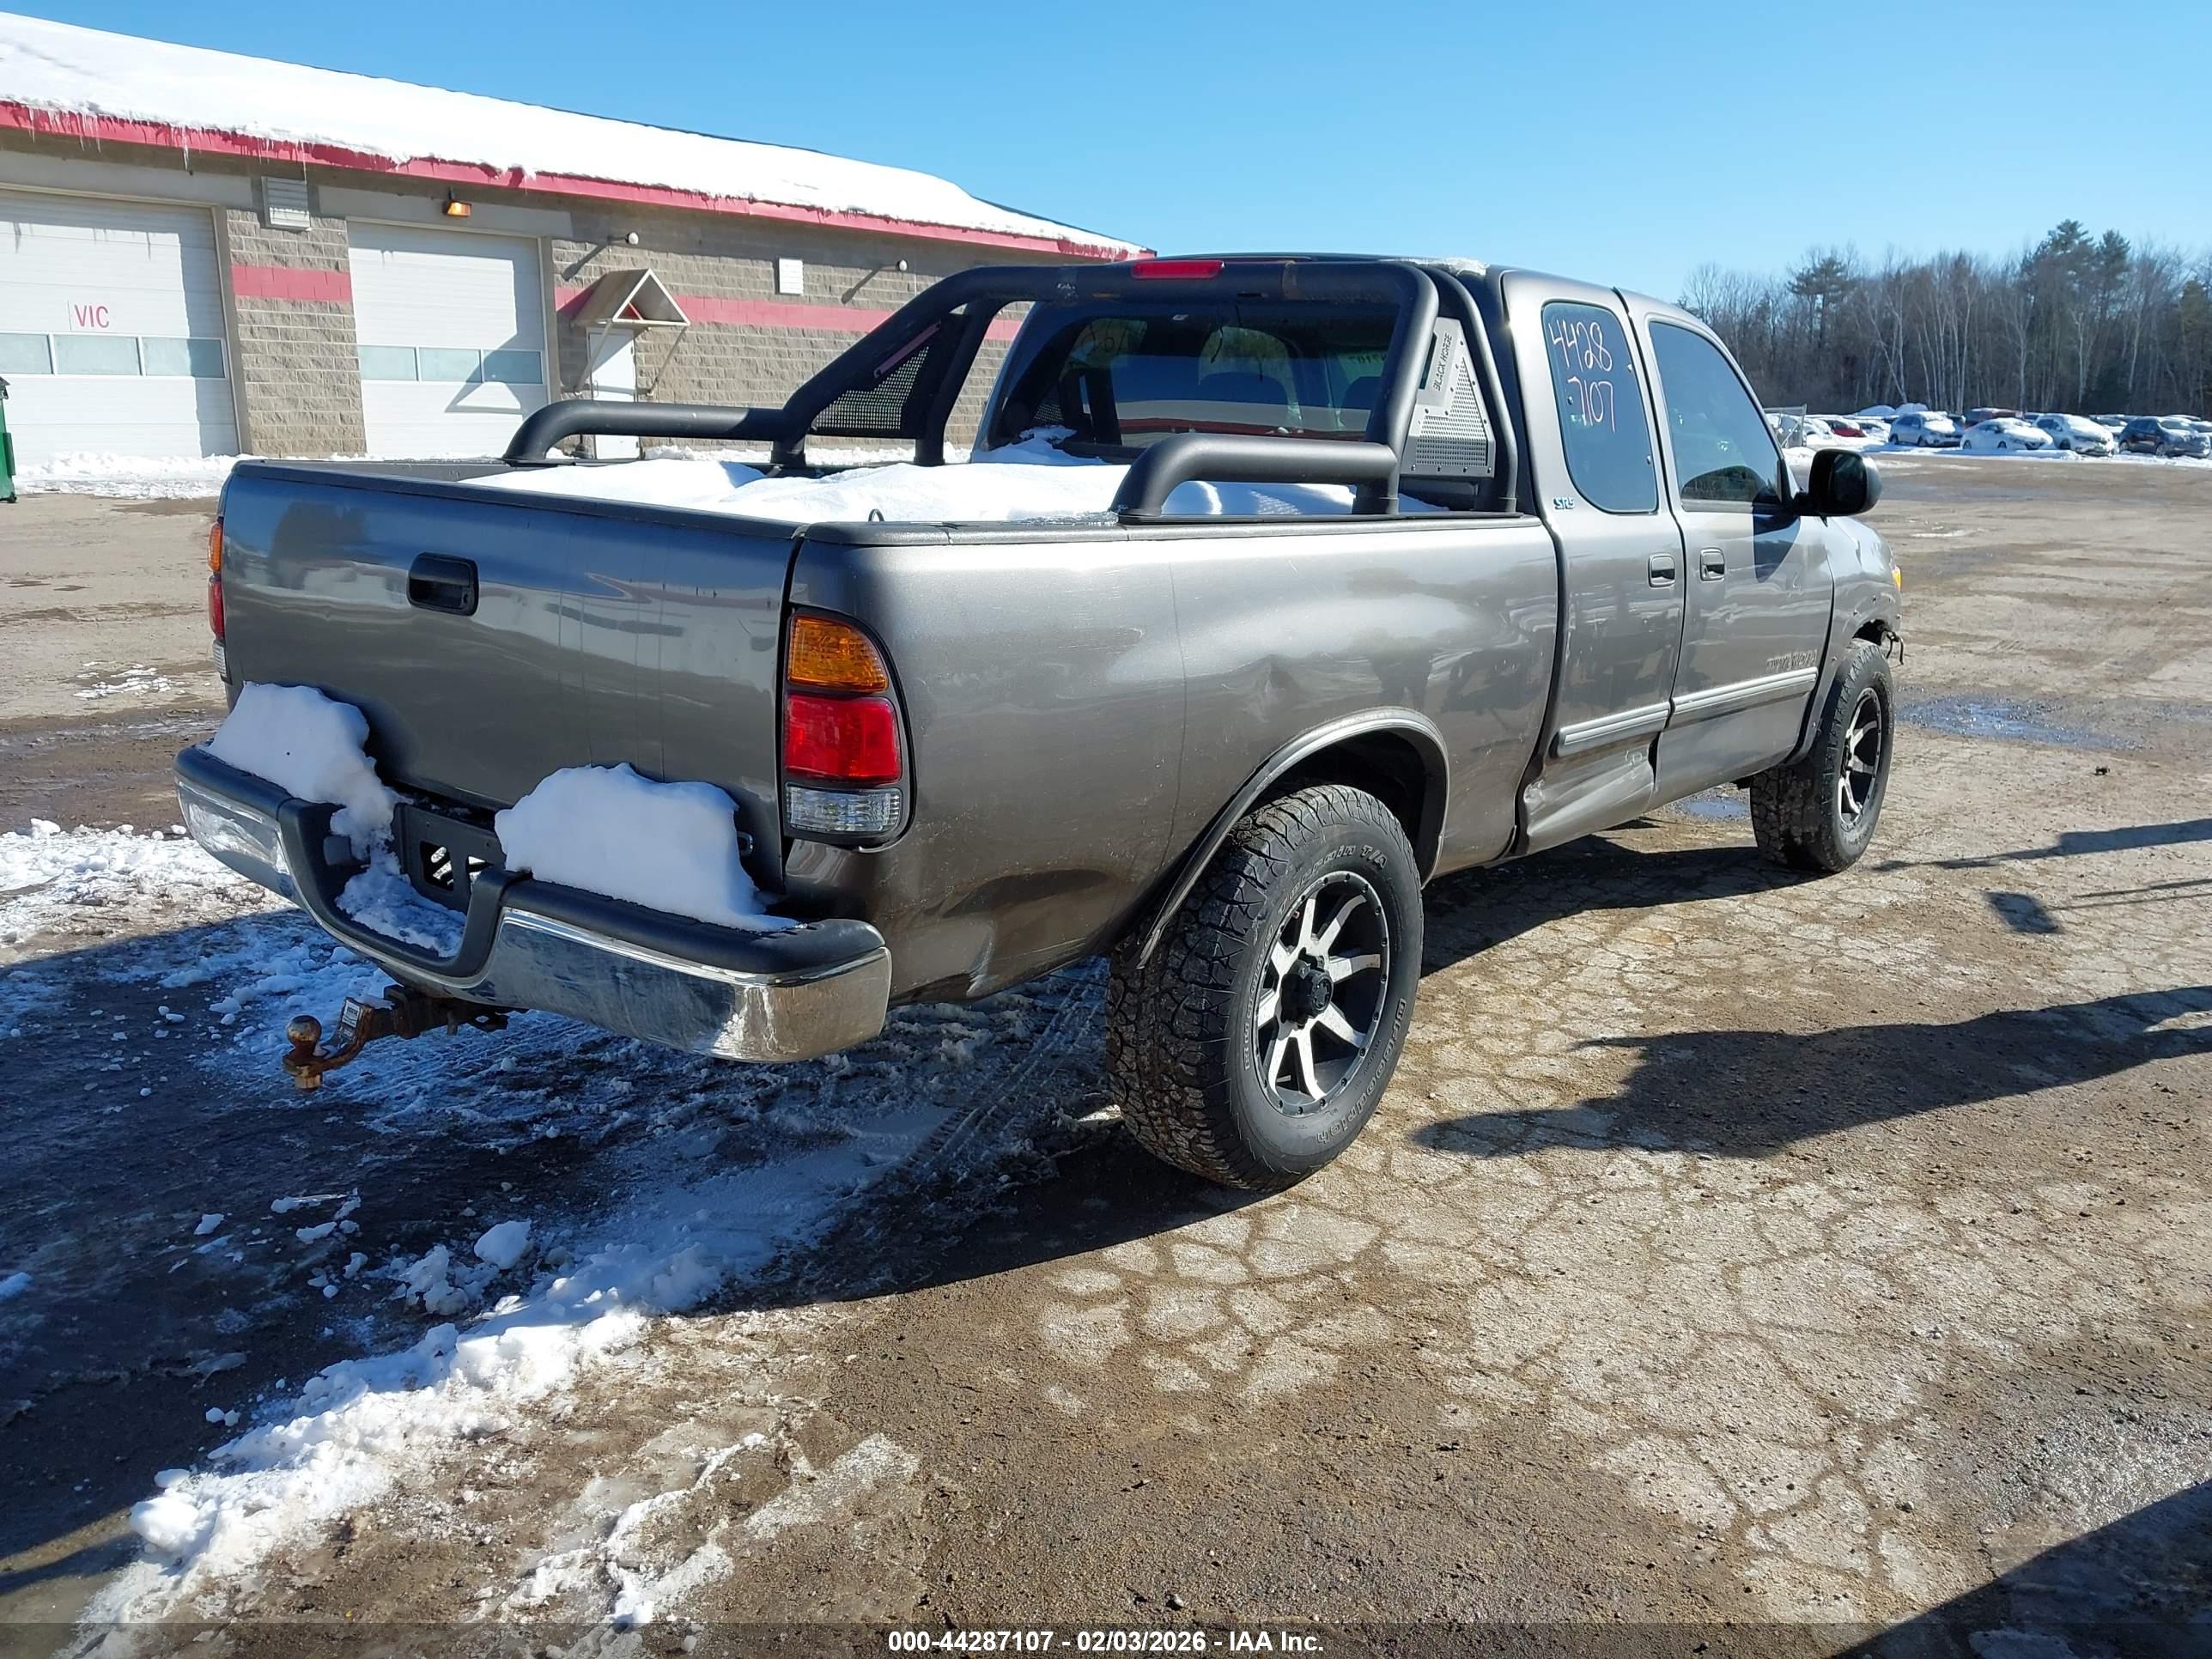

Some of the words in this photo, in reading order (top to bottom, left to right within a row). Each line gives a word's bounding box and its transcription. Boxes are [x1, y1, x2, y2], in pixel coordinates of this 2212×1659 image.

[74, 304, 110, 328] VIC
[1432, 362, 1446, 391] BLACK
[1439, 331, 1453, 362] HORSE
[1547, 319, 1613, 372] 4428
[1566, 376, 1616, 433] 7107
[1360, 844, 1388, 869] T/A
